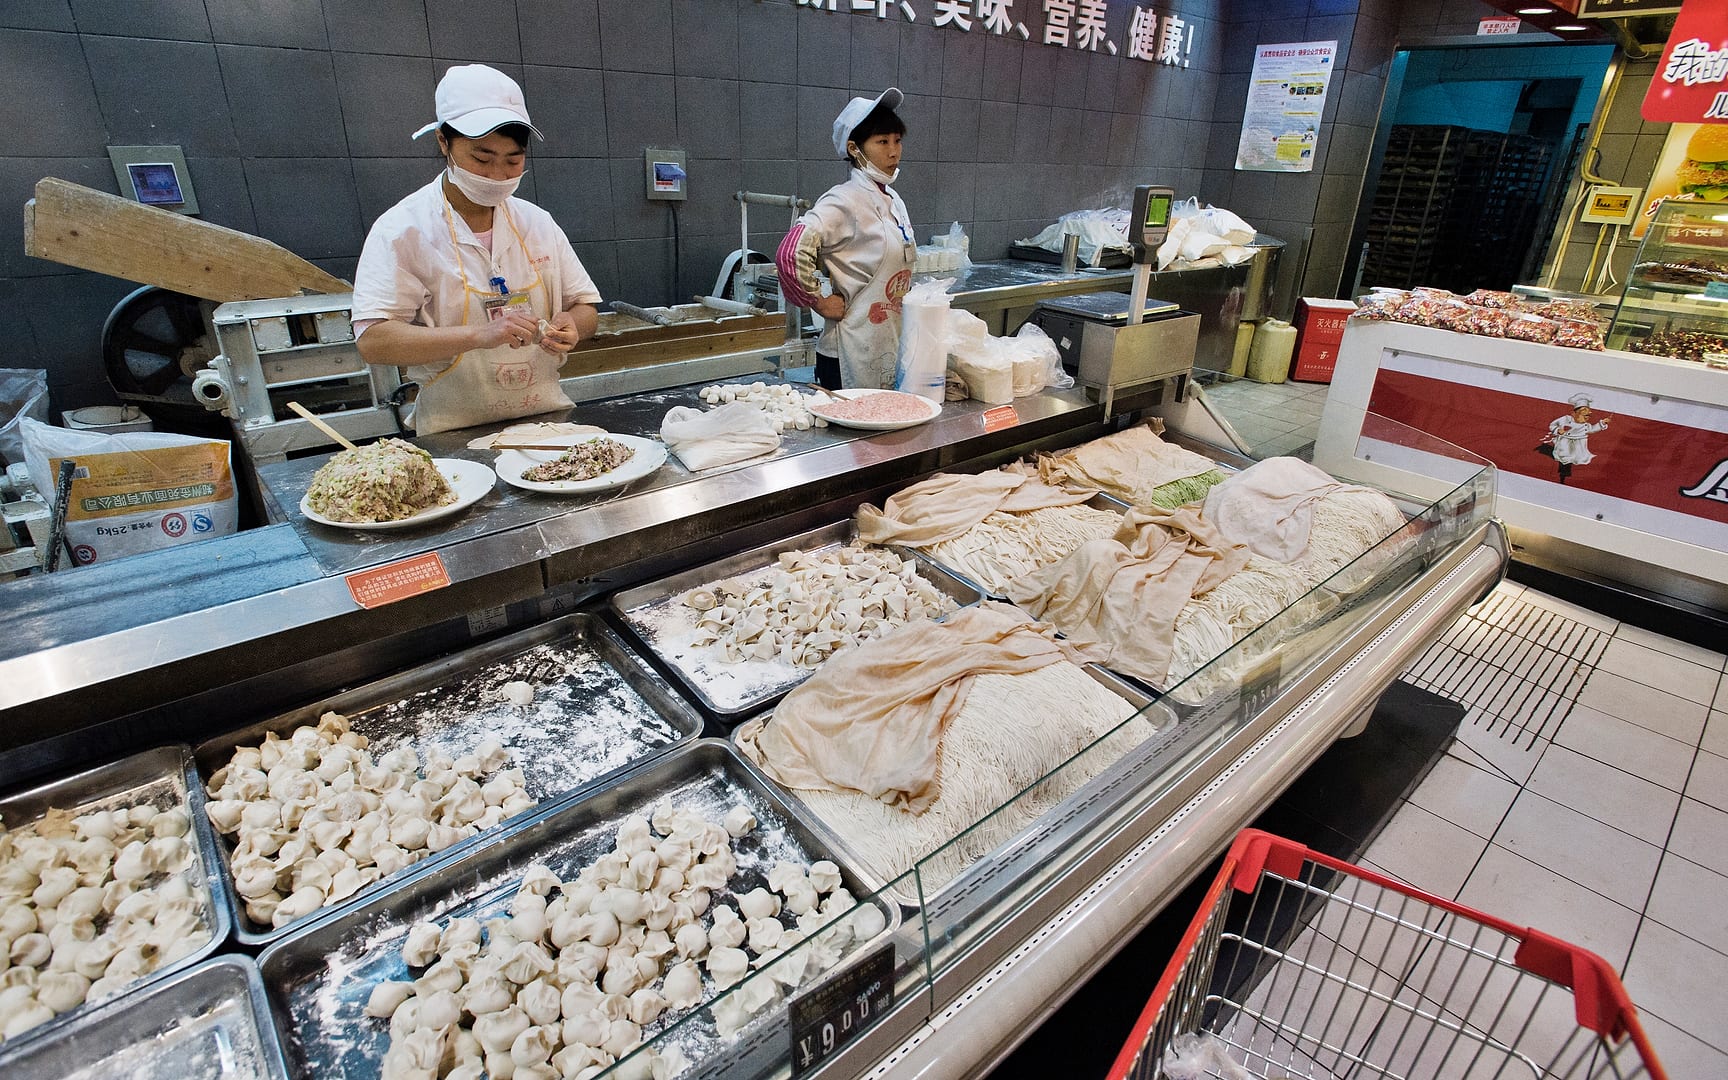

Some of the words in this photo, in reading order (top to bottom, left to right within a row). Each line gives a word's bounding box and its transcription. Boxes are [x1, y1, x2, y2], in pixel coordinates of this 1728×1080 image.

[797, 0, 1197, 67] 、美味、营养、健康!
[1316, 318, 1347, 329] 灭火器箱
[85, 484, 213, 510] 郑州金苑面业有限公司
